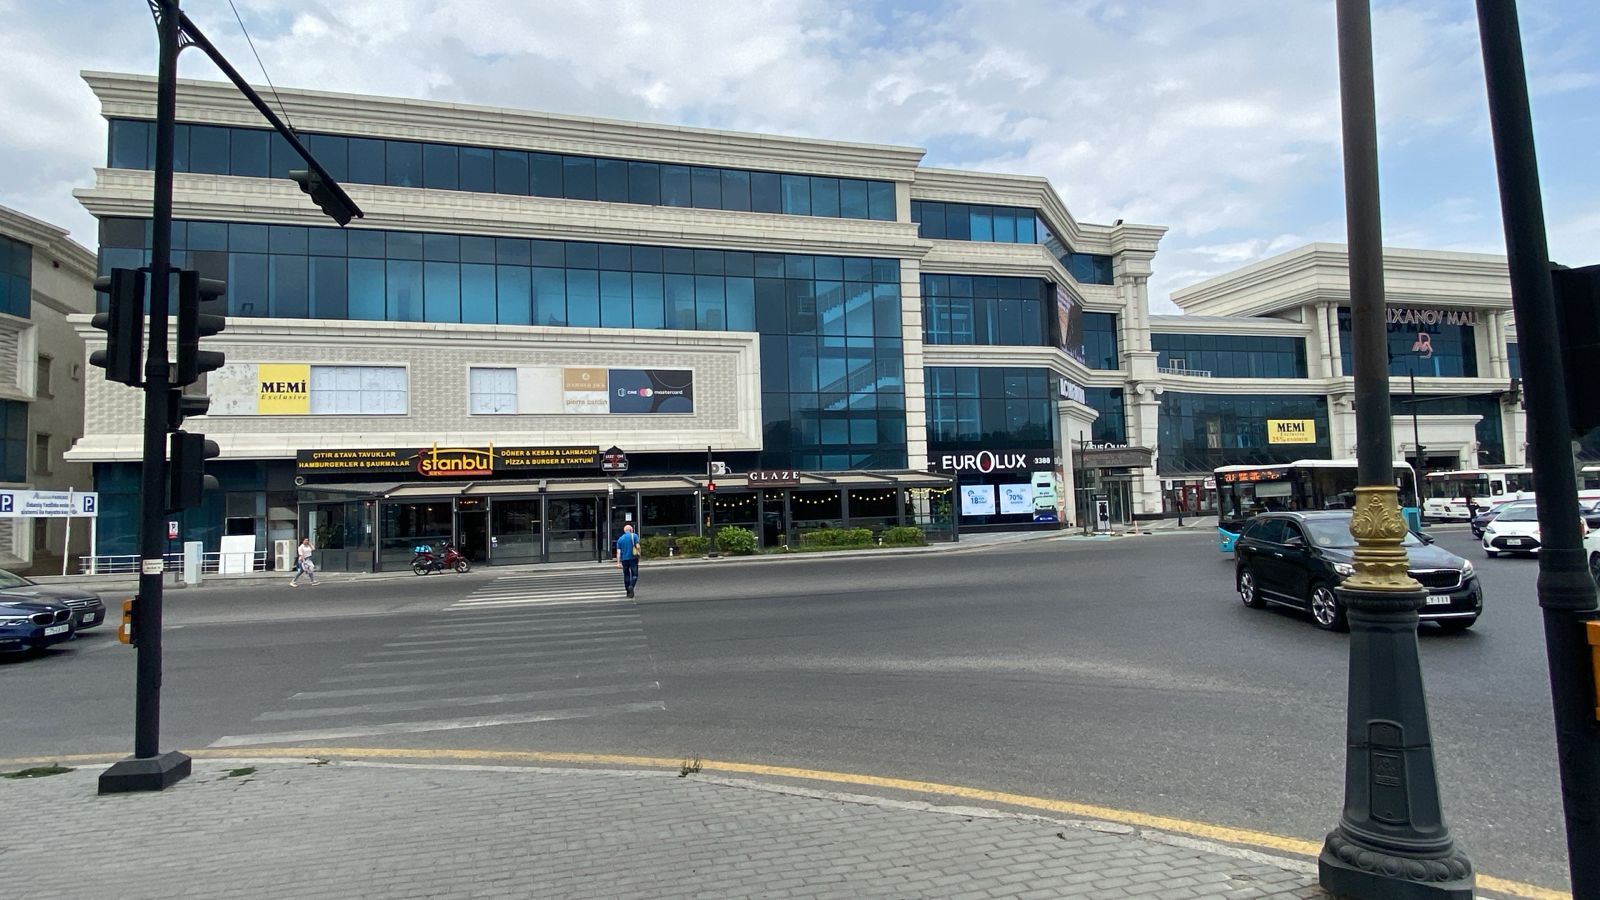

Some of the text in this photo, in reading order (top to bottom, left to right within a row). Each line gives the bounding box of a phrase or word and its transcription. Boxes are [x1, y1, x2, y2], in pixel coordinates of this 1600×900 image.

[1385, 308, 1443, 324] IXANOV
[942, 450, 1027, 473] EUROLUX
[749, 471, 800, 481] GLAZE
